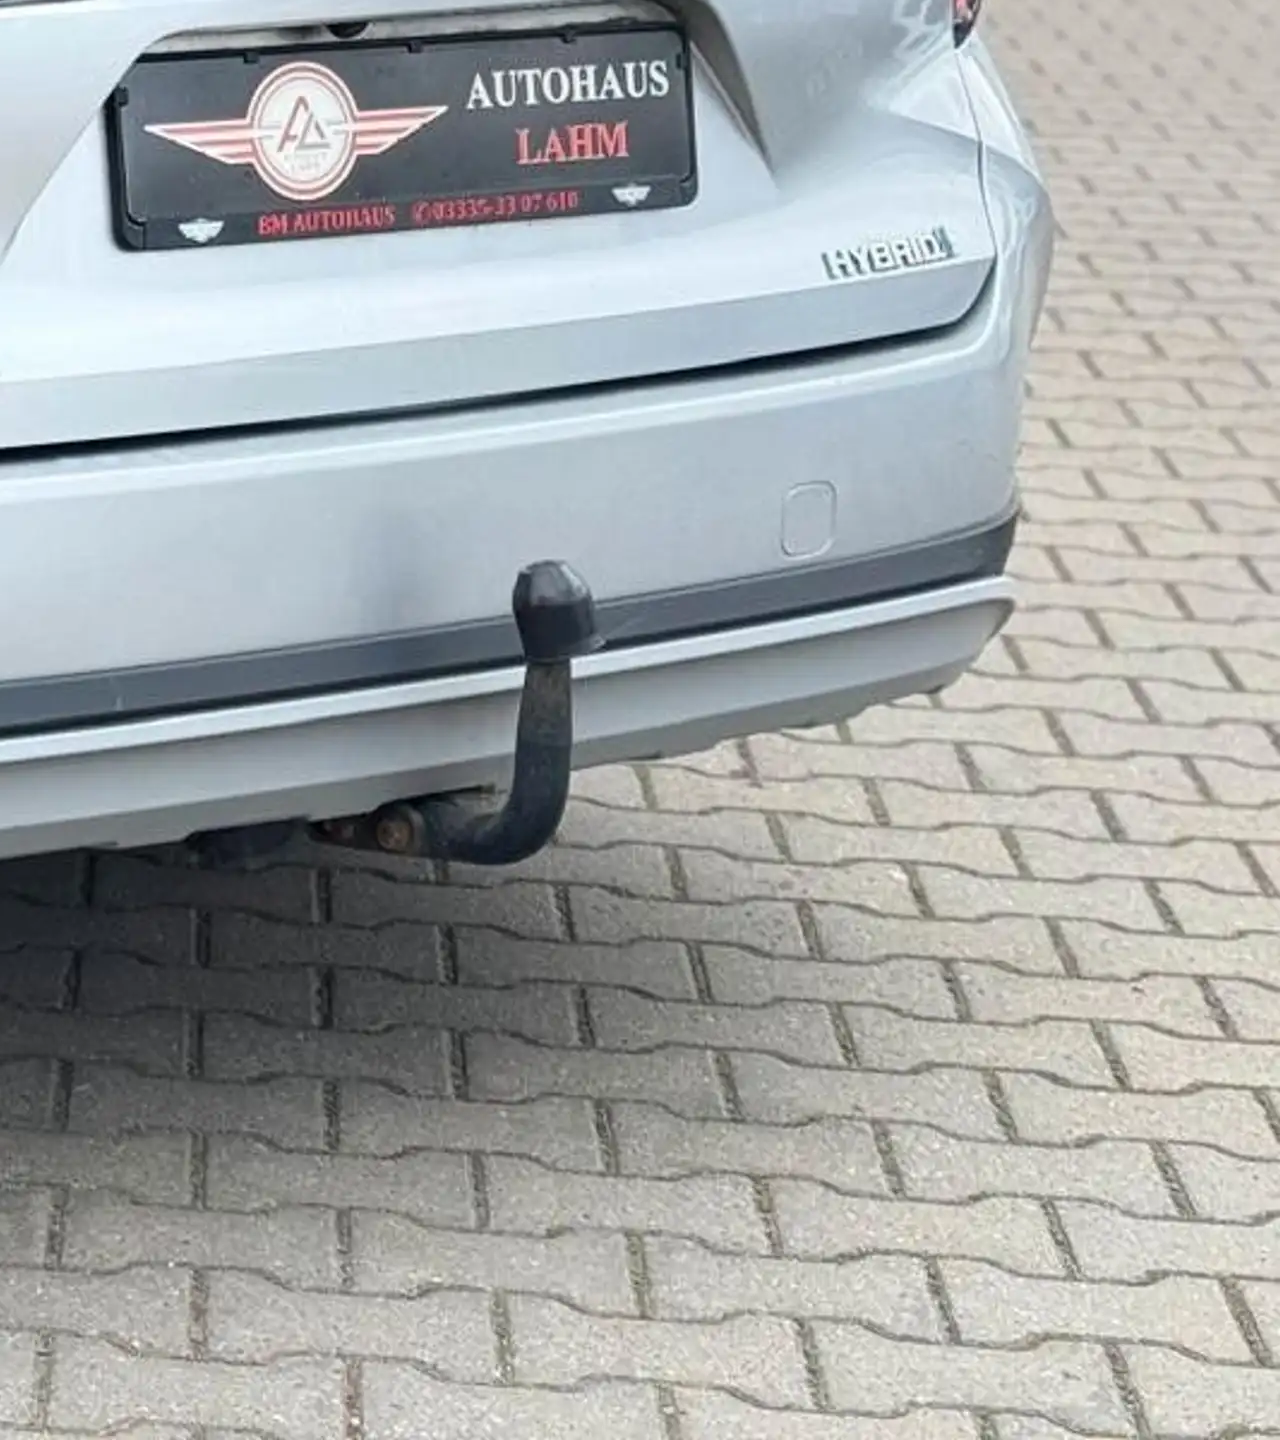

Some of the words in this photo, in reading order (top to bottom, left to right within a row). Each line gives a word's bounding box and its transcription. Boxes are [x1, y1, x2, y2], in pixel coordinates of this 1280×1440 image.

[466, 61, 669, 110] AUTOHAUS
[515, 120, 630, 166] LAHM
[294, 205, 396, 233] AUTOHAUS
[821, 231, 948, 281] HYBRID
